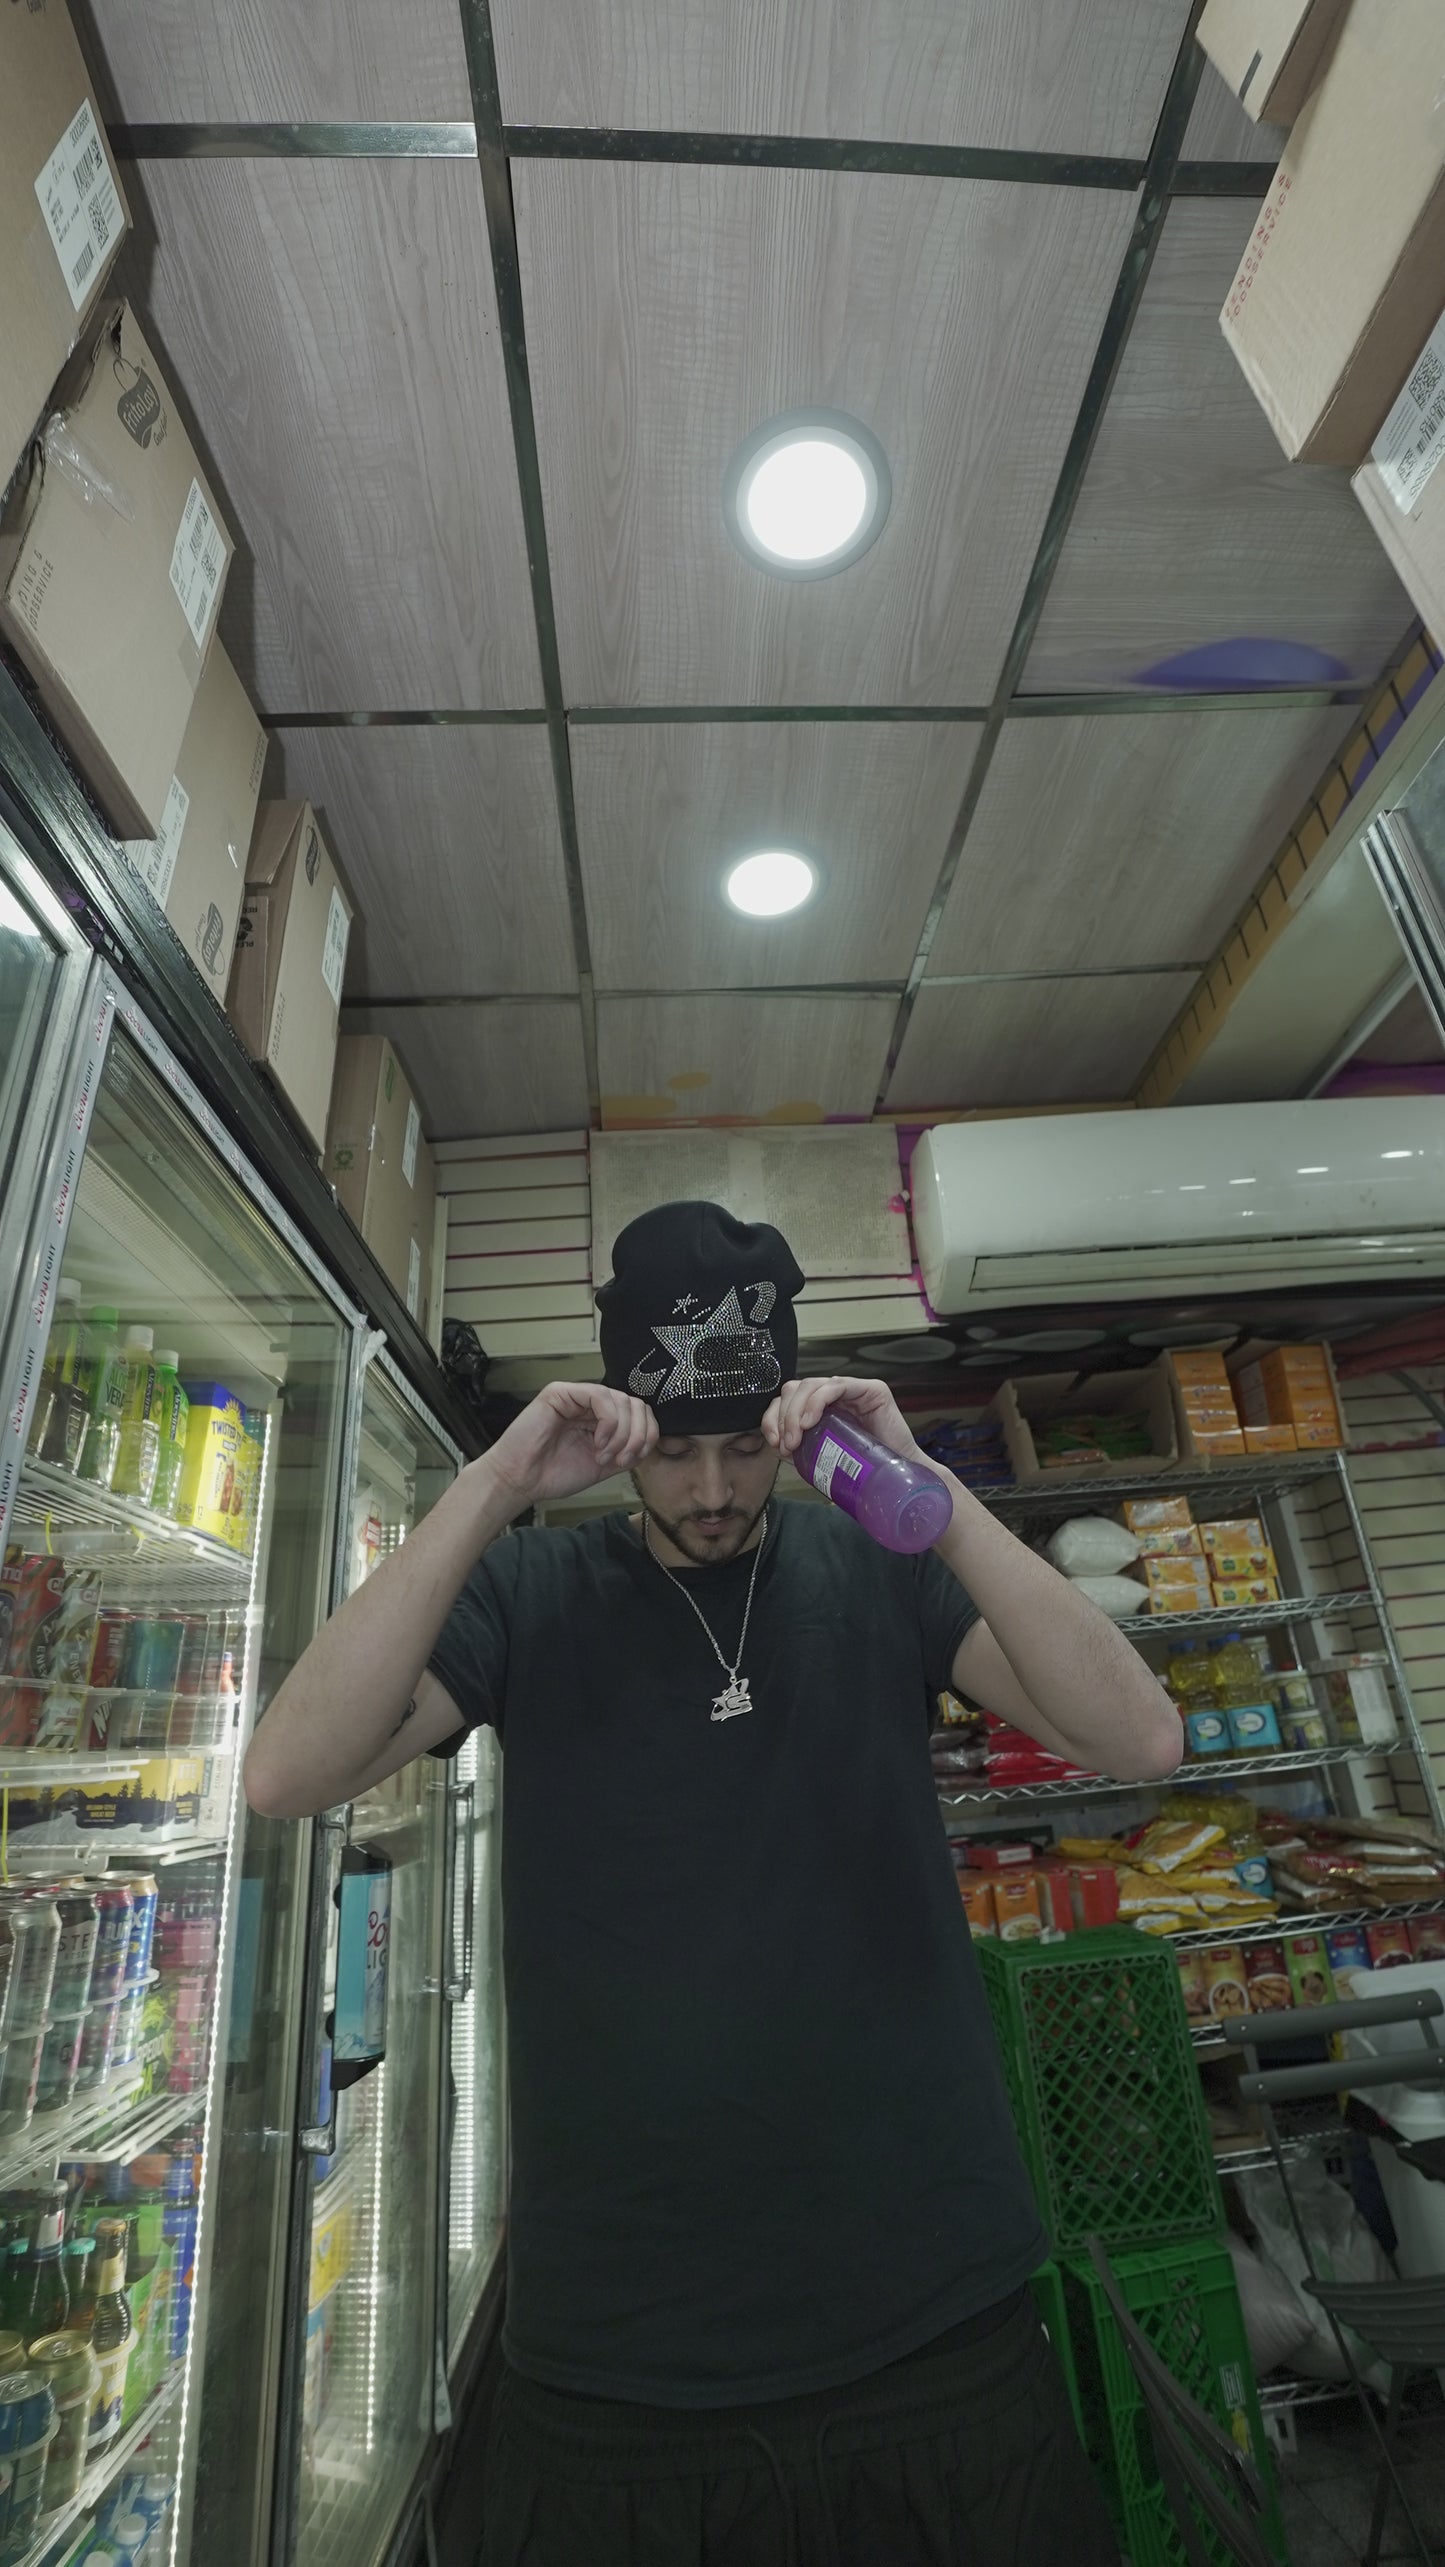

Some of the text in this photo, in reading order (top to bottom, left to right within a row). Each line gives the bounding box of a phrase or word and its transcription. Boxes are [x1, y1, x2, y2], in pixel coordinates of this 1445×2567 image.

[82, 1060, 95, 1093] LIGHT
[53, 1150, 77, 1225] Coors LIGHT
[33, 1245, 56, 1325] Coors LIGHT
[12, 1348, 36, 1434] Coors LIGHT
[212, 1421, 236, 1439] TWISTED
[0, 1462, 14, 1503] LIGHT
